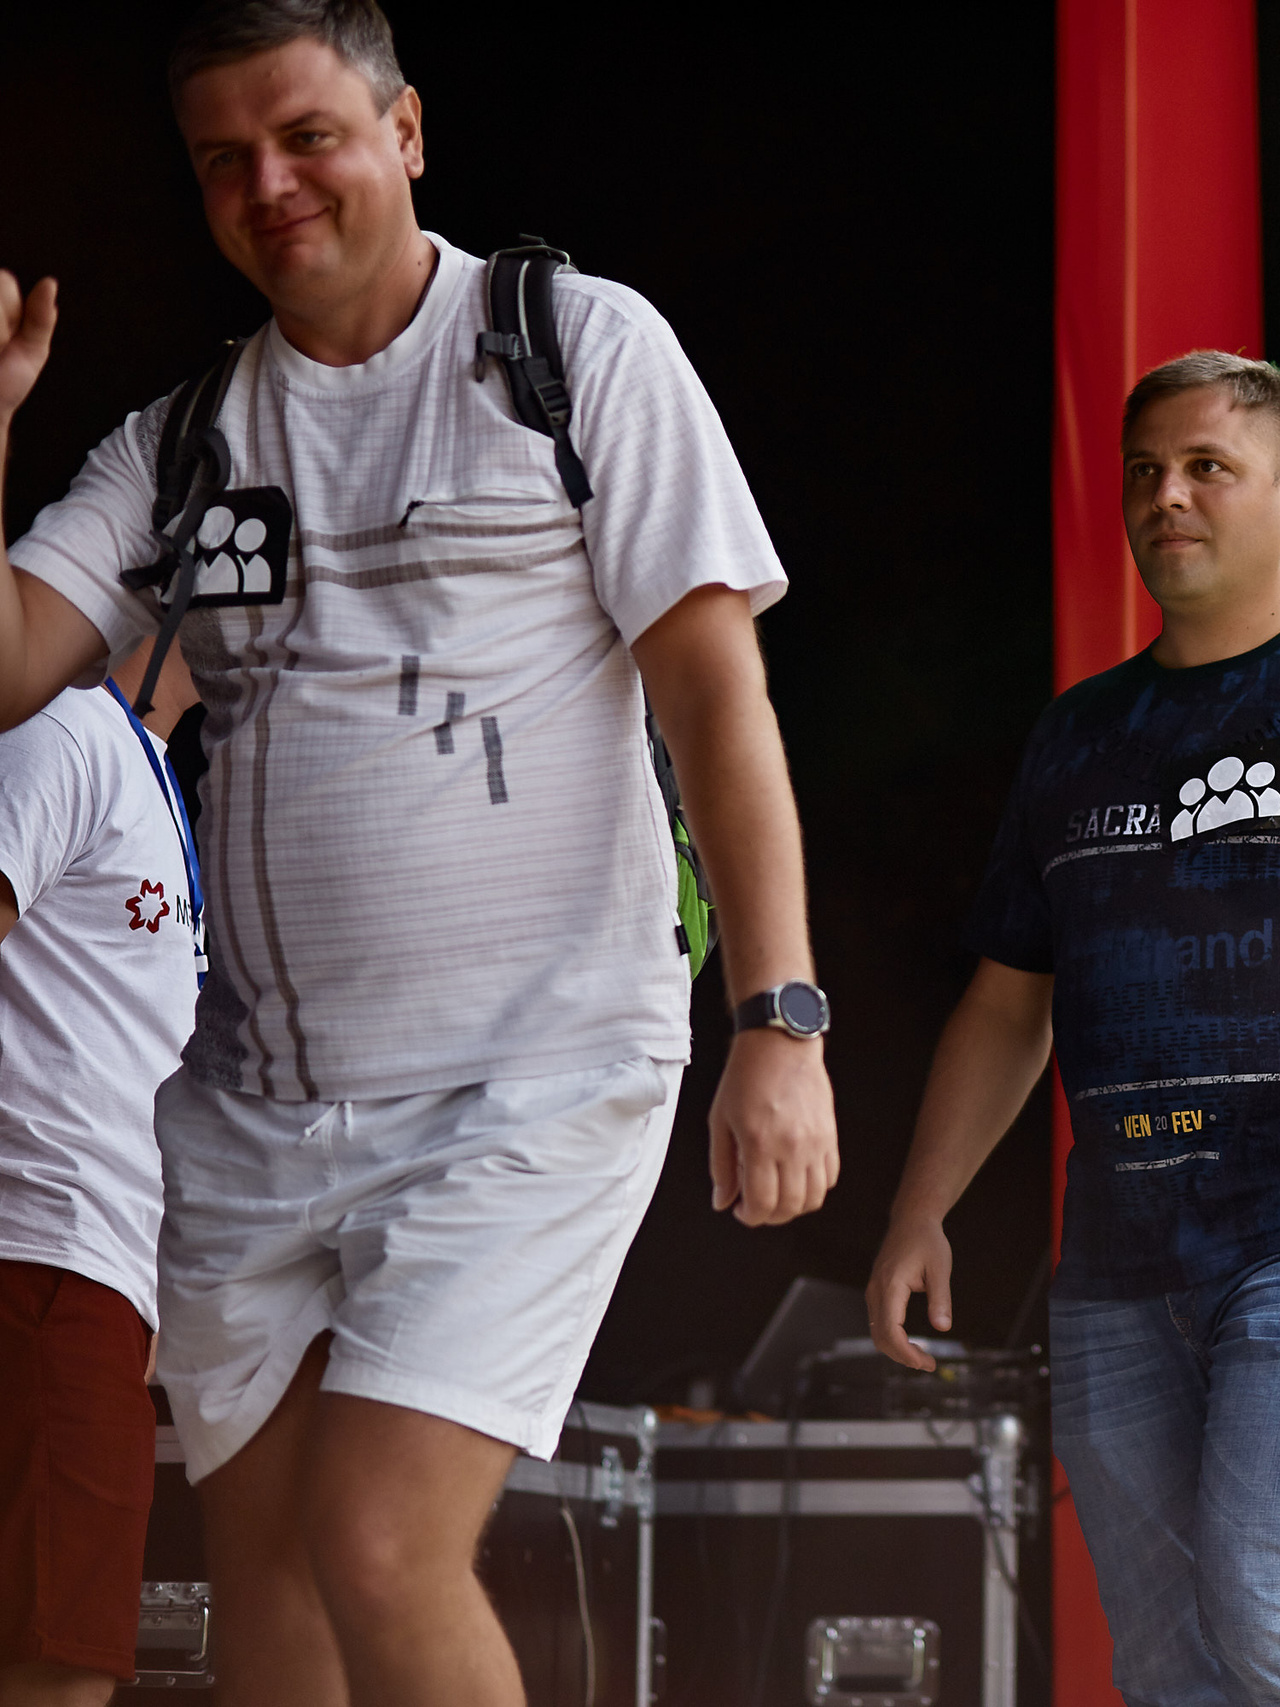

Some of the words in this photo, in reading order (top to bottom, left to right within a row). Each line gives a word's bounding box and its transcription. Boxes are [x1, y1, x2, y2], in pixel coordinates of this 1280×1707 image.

[1123, 1113, 1152, 1139] VEN
[1154, 1115, 1168, 1131] 20
[1171, 1109, 1203, 1135] FEV
